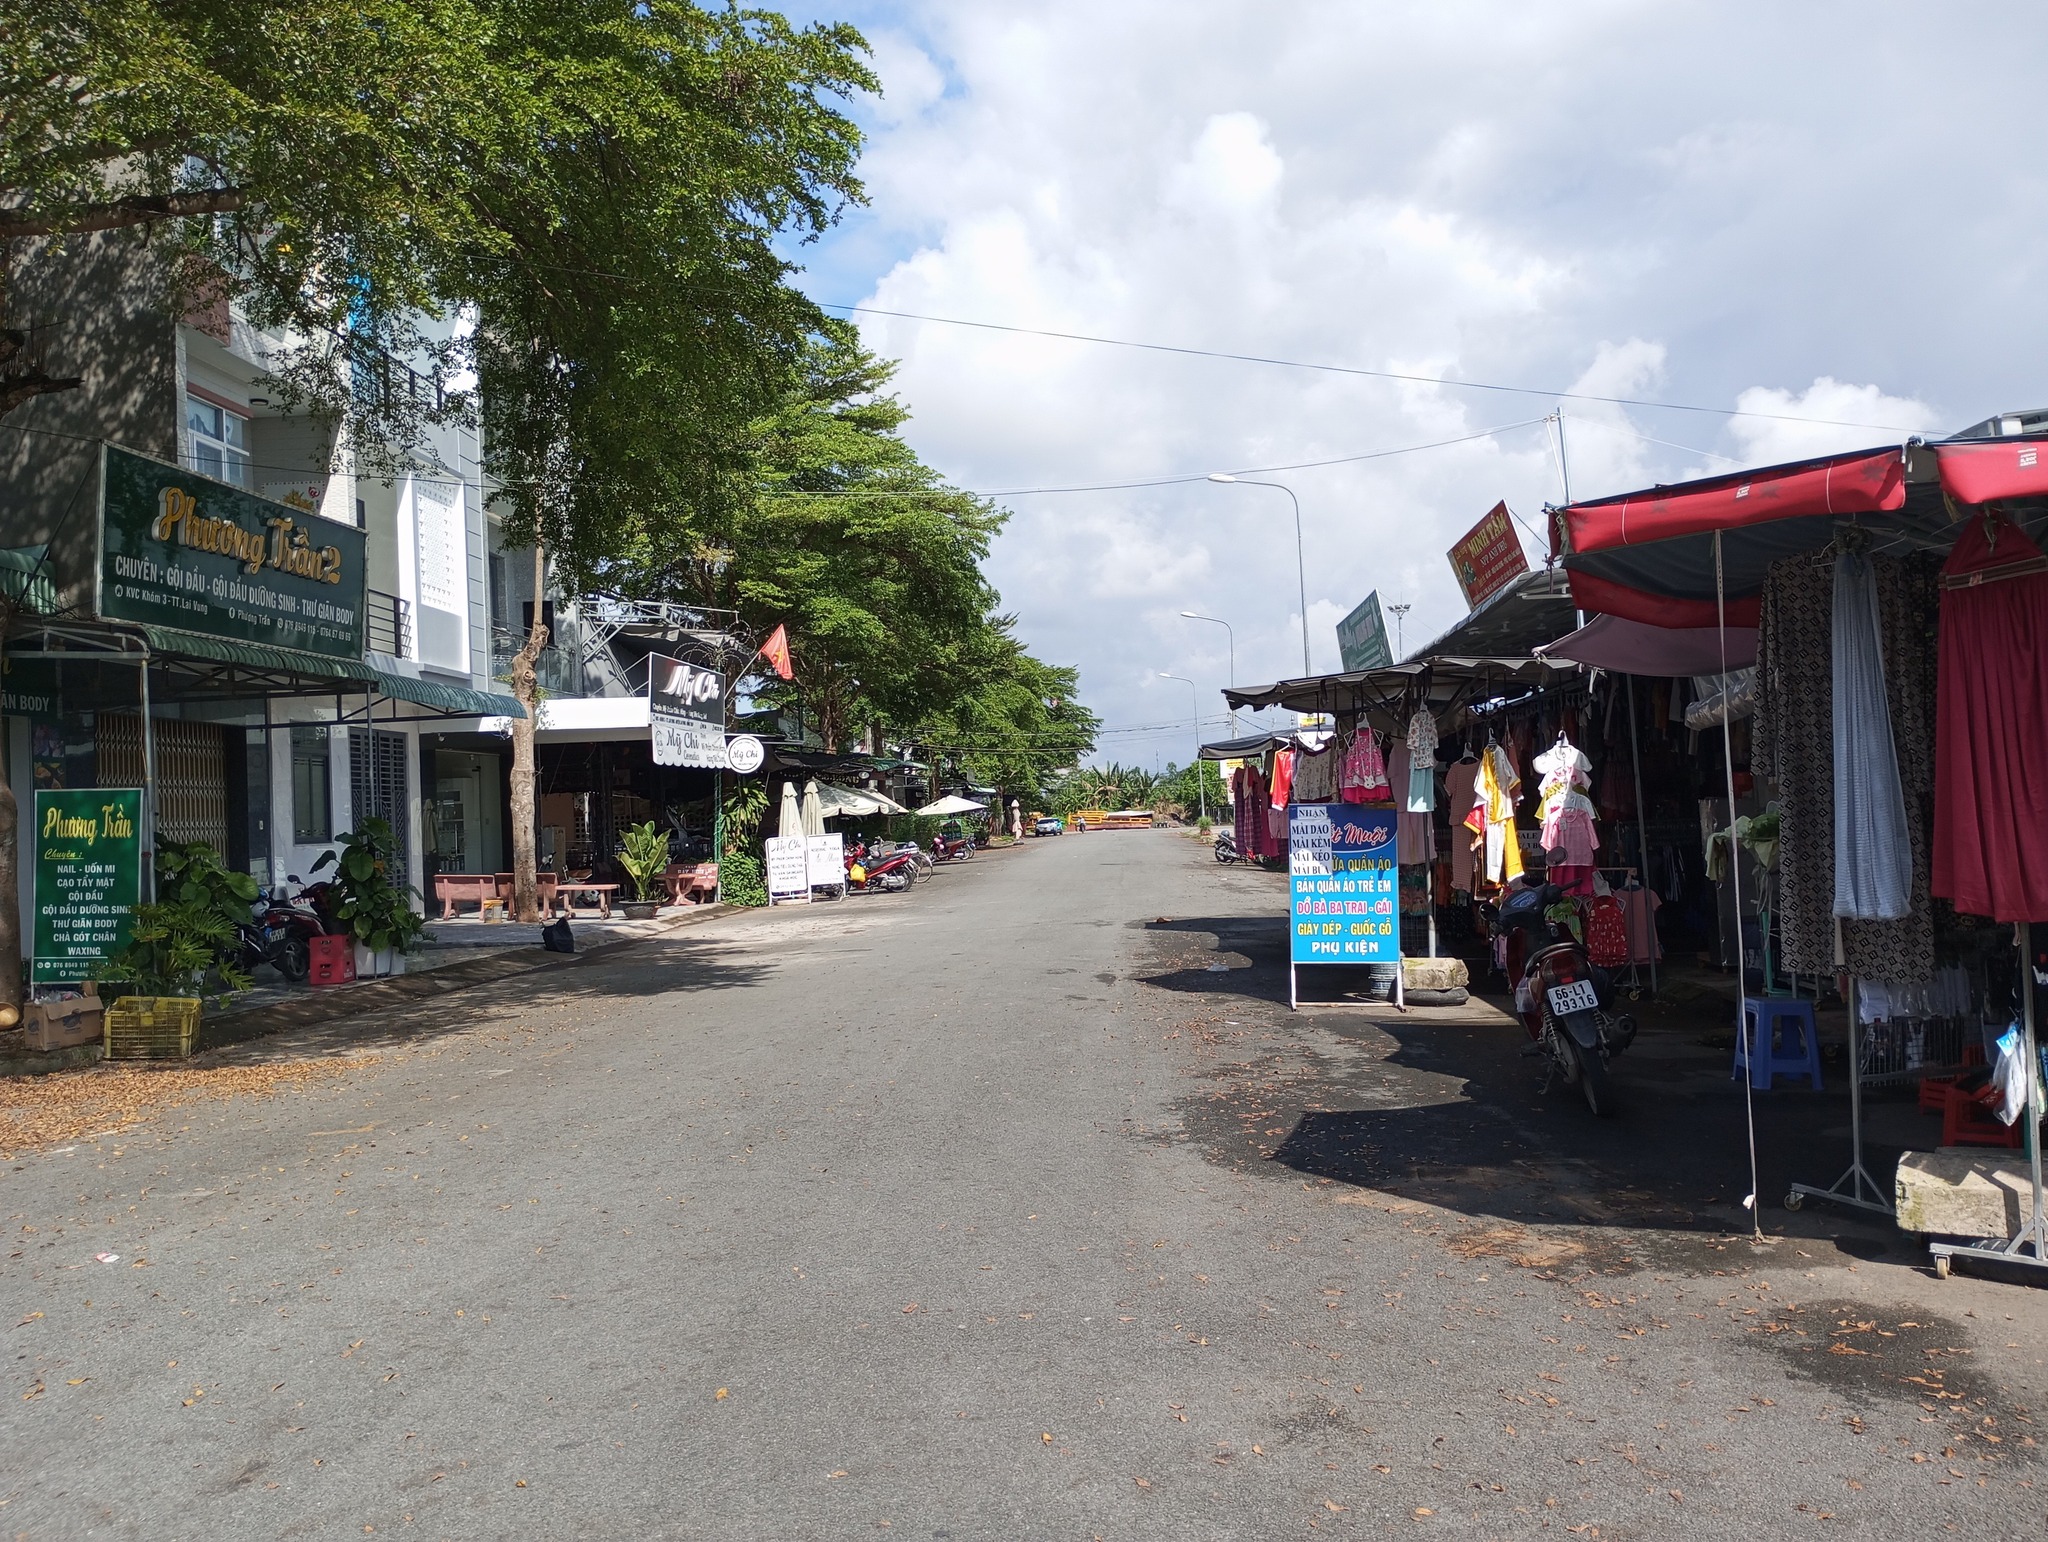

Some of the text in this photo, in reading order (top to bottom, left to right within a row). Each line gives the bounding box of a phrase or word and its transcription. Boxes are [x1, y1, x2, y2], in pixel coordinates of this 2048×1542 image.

[153, 487, 267, 575] Phương
[115, 555, 158, 585] CHUYÊN
[166, 565, 183, 593] GỘI
[185, 564, 206, 594] ĐẦU
[212, 574, 228, 601] GỘI
[229, 575, 247, 602] ĐẦU
[249, 585, 276, 609] DƯỠNG
[277, 593, 296, 613] SINH
[301, 598, 318, 617] THƯ
[317, 600, 335, 621] GIÃN
[335, 605, 354, 626] BODY
[126, 586, 140, 600] KVC
[141, 589, 161, 604] Khóm
[20, 694, 50, 712] BODY
[666, 728, 682, 756] Mỹ
[684, 732, 699, 749] Chi
[43, 803, 133, 846] Phương Trần
[1292, 822, 1329, 835] MÀI DAO
[1292, 836, 1331, 848] MÀI KÈM
[1344, 822, 1388, 846] Muội
[1293, 849, 1330, 862] MÀI KÉO
[1347, 853, 1375, 873] QUẦN
[1377, 855, 1392, 871] ÁO
[57, 864, 76, 874] NAIL
[84, 862, 102, 874] UỐN
[104, 864, 116, 873] MI
[57, 878, 75, 889] CẠO
[77, 874, 94, 887] TẨY
[1296, 875, 1392, 894] BÁN QUẦN ÁO TRẺ EM
[68, 890, 84, 903] GỘI
[42, 903, 58, 916] GỘI
[80, 903, 109, 914] DƯỠNG
[1296, 897, 1312, 914] ĐỒ
[1313, 898, 1327, 914] BÀ
[1329, 900, 1343, 914] BA
[1344, 901, 1368, 914] TRAI
[1375, 900, 1393, 914] GÁI
[52, 917, 118, 929] THƯ GIÃN BODY
[1297, 920, 1320, 935] GIÀY
[1322, 920, 1342, 935] DÉP
[1350, 918, 1377, 936] GUỐC
[1378, 917, 1392, 935] GỖ
[53, 929, 116, 942] CHÀ GÓT CHÂN
[67, 946, 101, 956] WAXING
[1311, 939, 1379, 955] PHỤ KIỆN
[1554, 984, 1586, 1000] 66-L1
[1555, 994, 1595, 1013] 293.16
